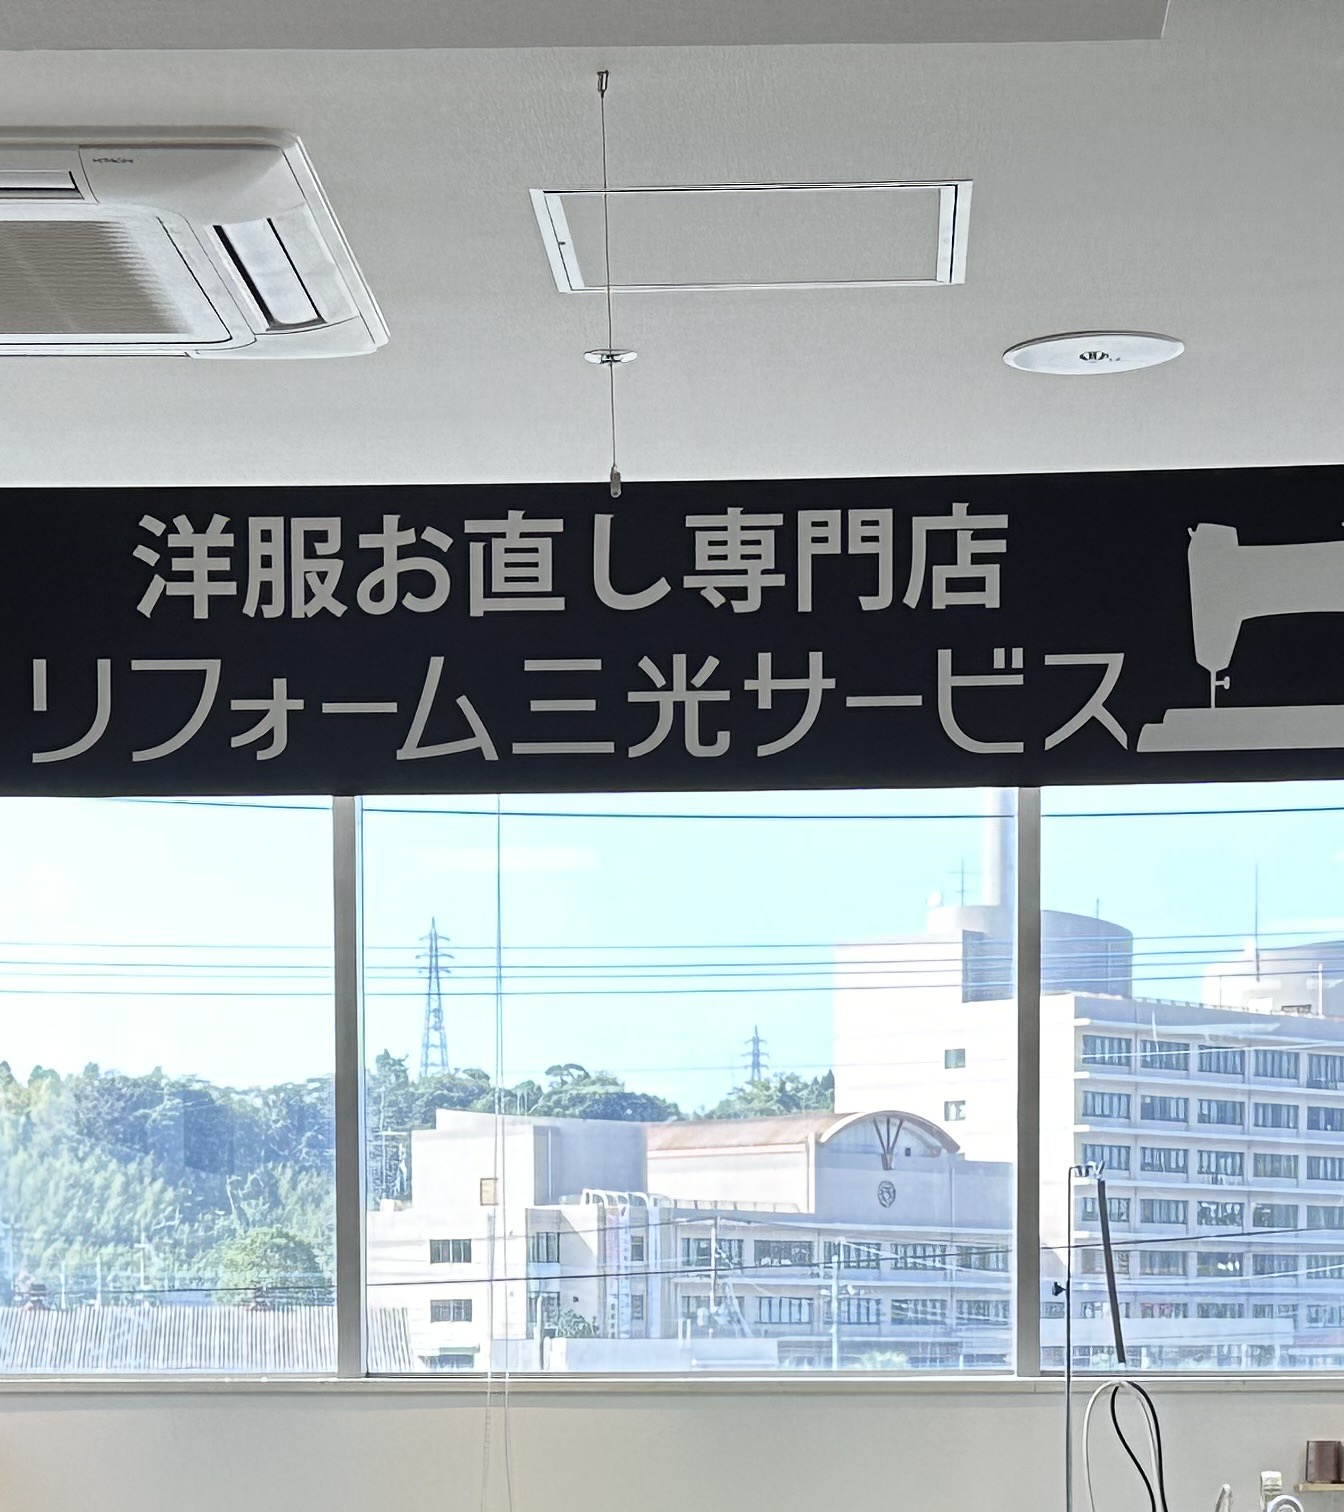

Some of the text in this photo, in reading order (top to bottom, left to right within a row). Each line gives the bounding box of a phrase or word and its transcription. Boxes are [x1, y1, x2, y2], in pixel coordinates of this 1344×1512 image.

[132, 503, 1010, 620] 洋服お直し専門店
[30, 647, 1130, 764] リフォーム三光サービス
